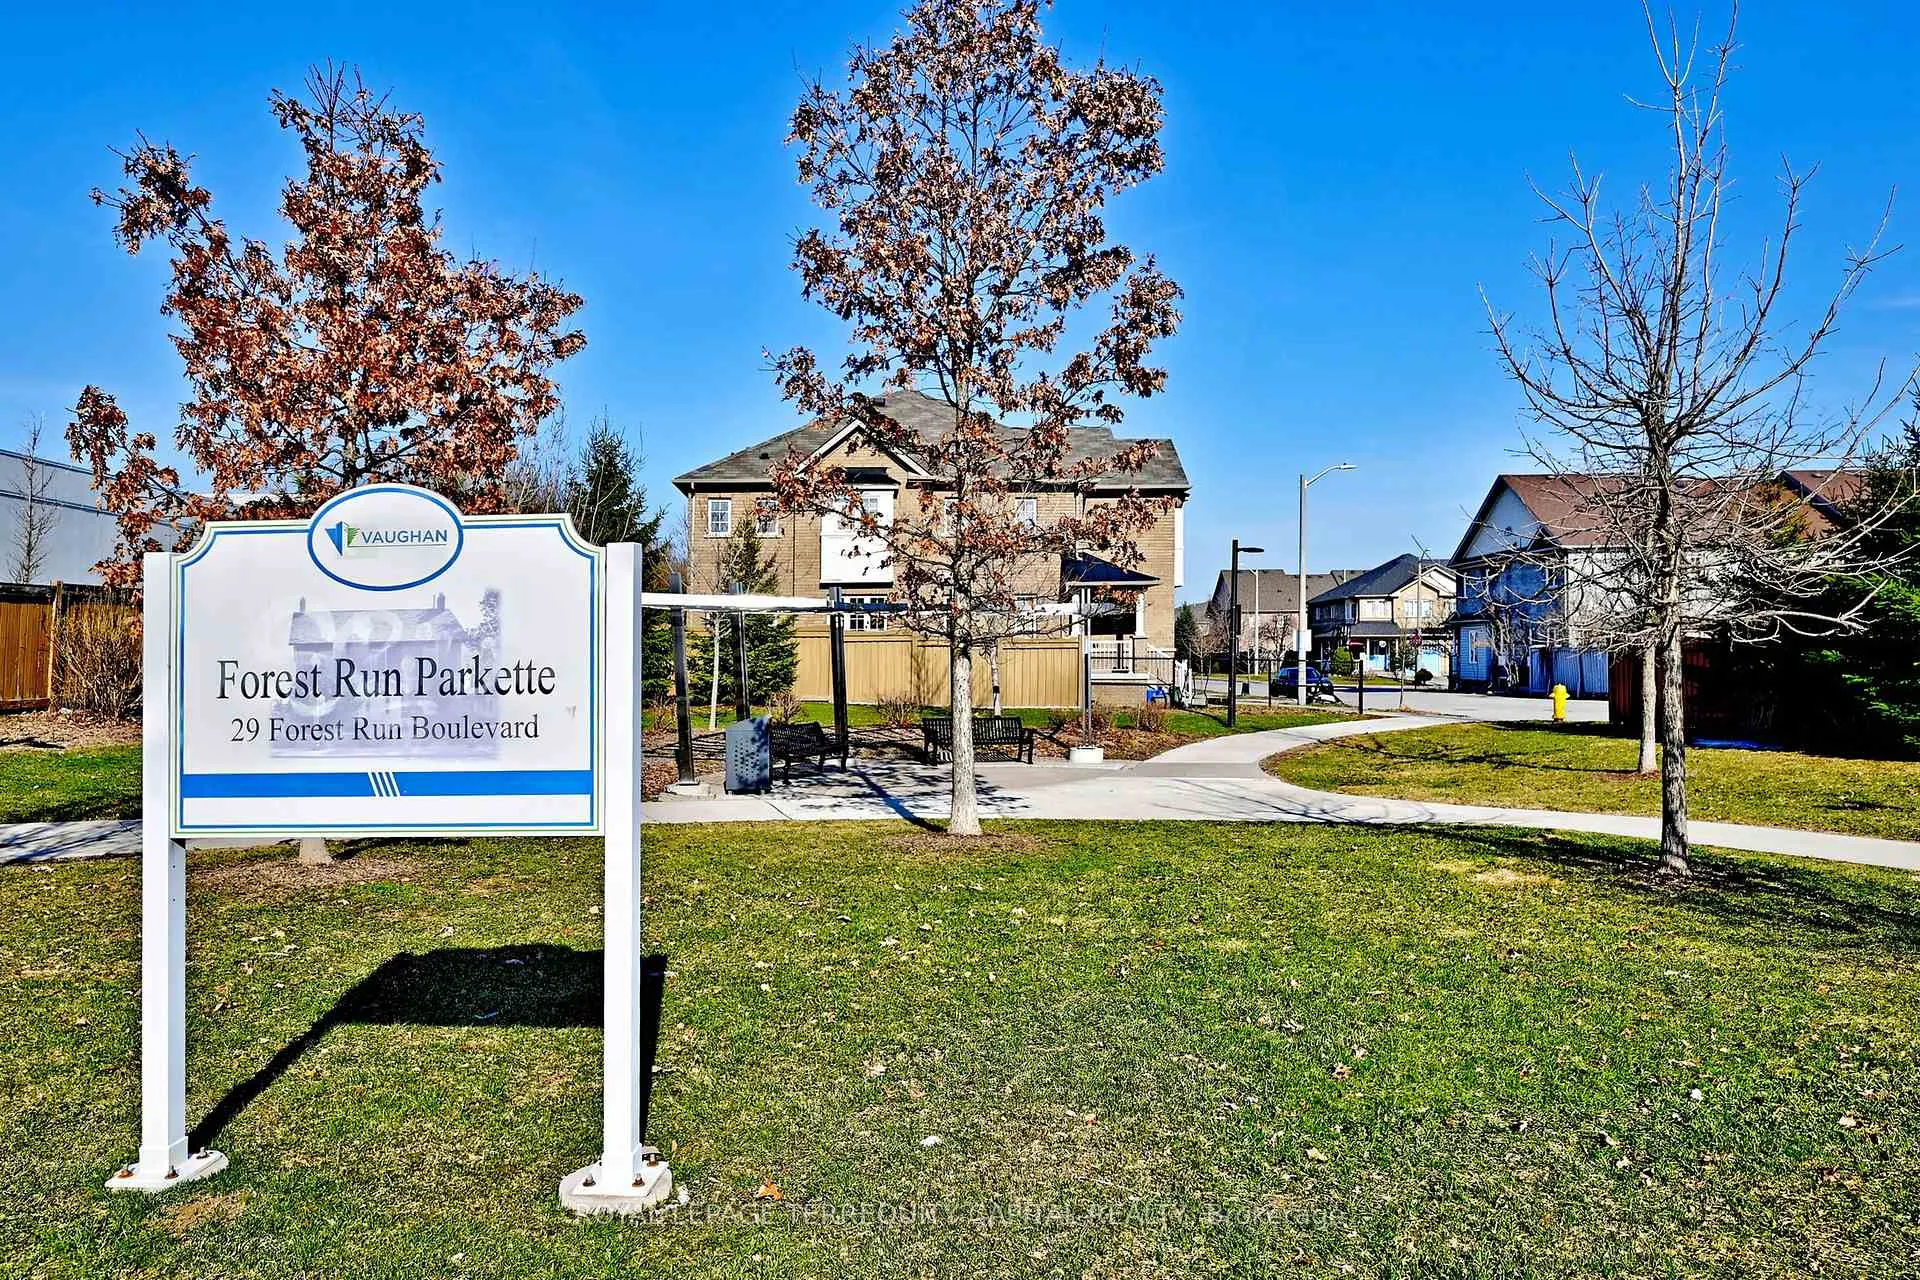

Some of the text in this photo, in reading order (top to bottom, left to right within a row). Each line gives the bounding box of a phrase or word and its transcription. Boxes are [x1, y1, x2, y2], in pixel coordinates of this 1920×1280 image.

[361, 529, 448, 544] VAUGHAN
[216, 654, 556, 700] Forest Run Parkette
[231, 713, 540, 742] 29 Forest Run Boulevard
